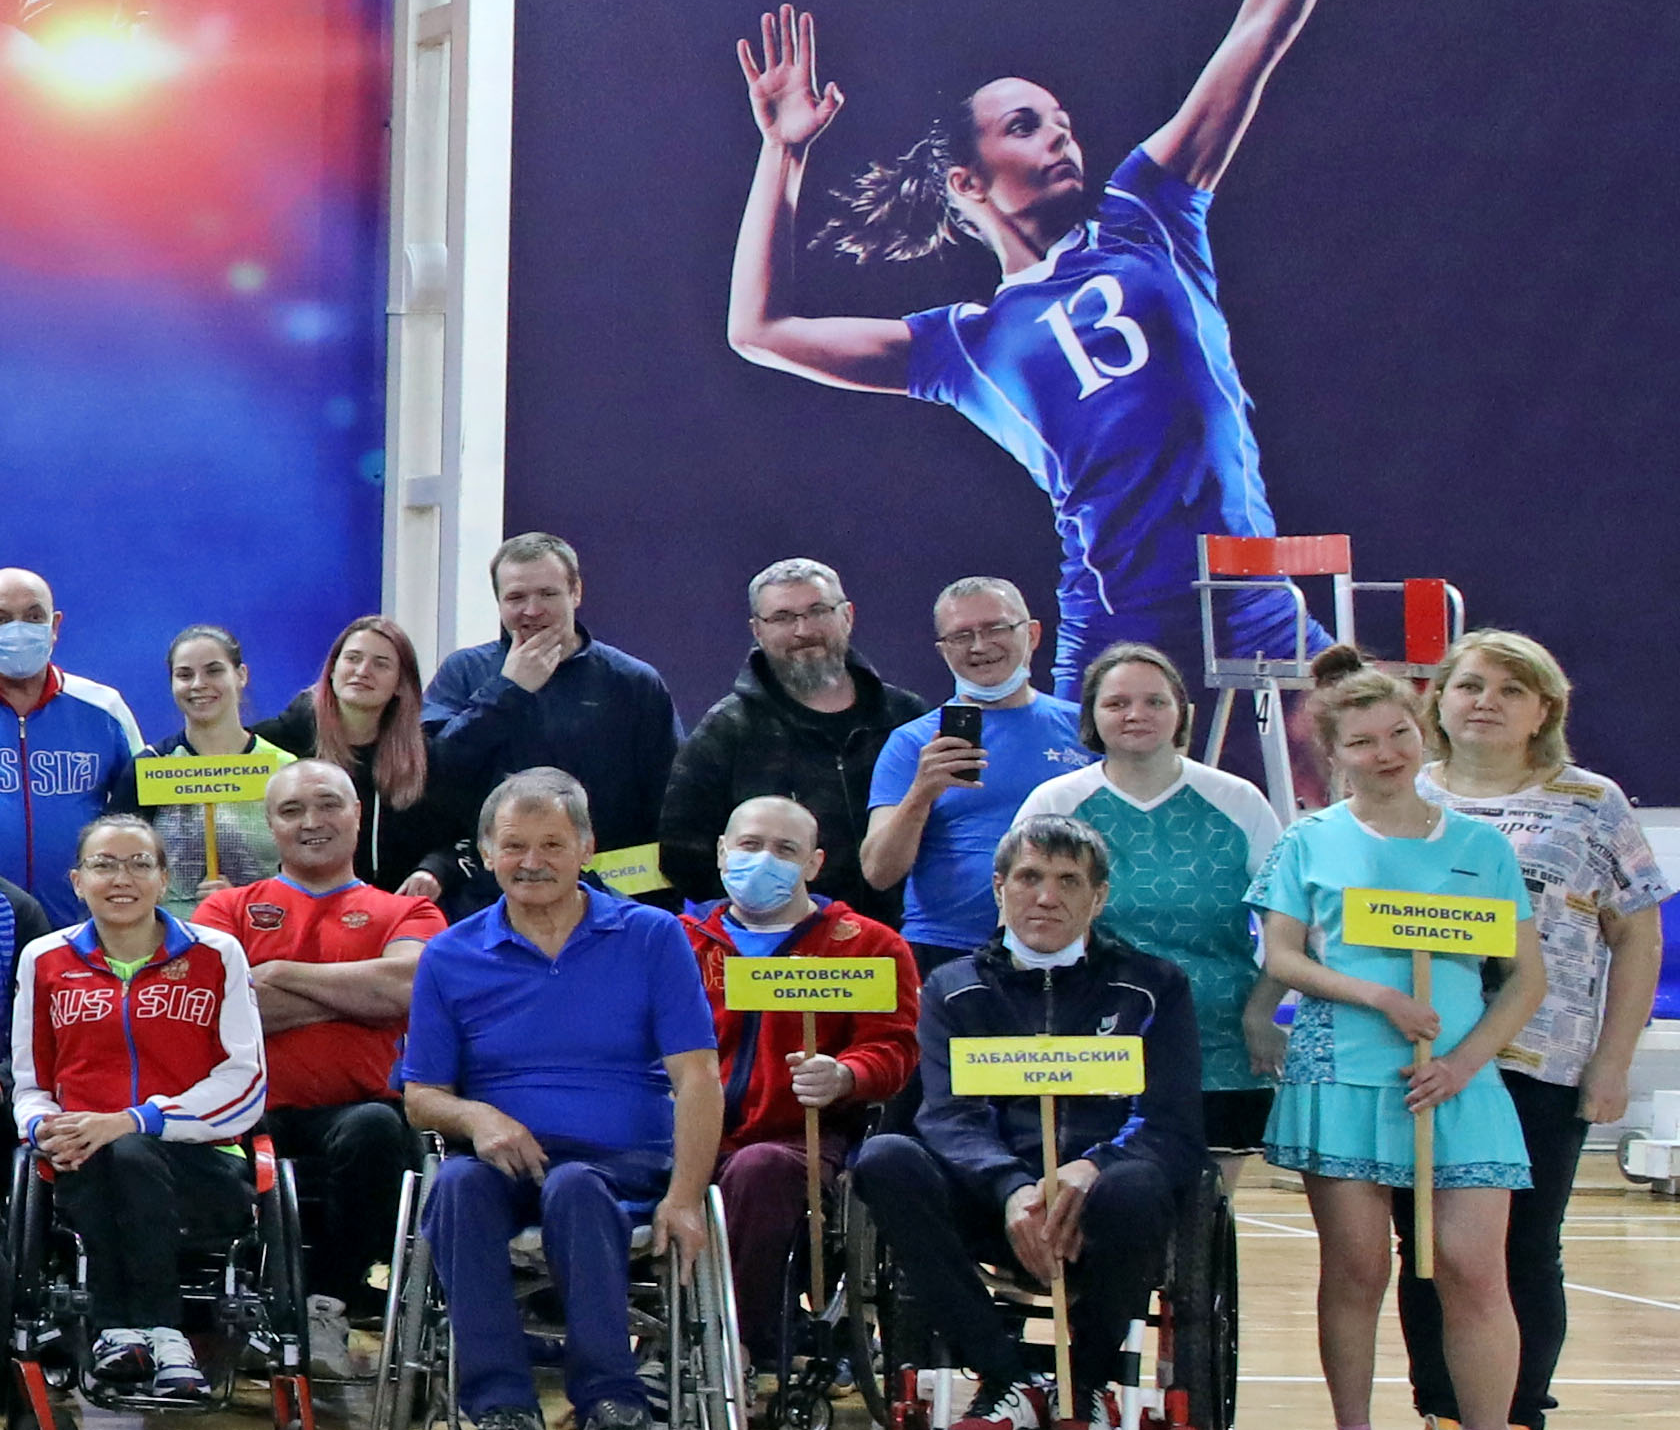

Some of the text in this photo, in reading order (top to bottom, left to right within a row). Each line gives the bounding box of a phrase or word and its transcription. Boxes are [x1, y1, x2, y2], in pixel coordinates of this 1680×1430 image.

[1035, 273, 1150, 400] 13
[1256, 692, 1270, 733] 4
[145, 763, 269, 779] НОВОСИБИРСКАЯ
[174, 781, 240, 795] ОБЛАСТЬ
[597, 863, 648, 881] ОСКВА
[1368, 902, 1496, 924] УЛЬЯНОВСКАЯ
[1392, 923, 1473, 941] ОБЛАСТЬ
[751, 968, 874, 982] САРАТОВСКАЯ
[773, 986, 853, 1000] ОБЛАСТЬ
[966, 1049, 1130, 1065] ЗАБАЙКАЛЬСКИЙ
[1023, 1066, 1073, 1083] КРАЙ
